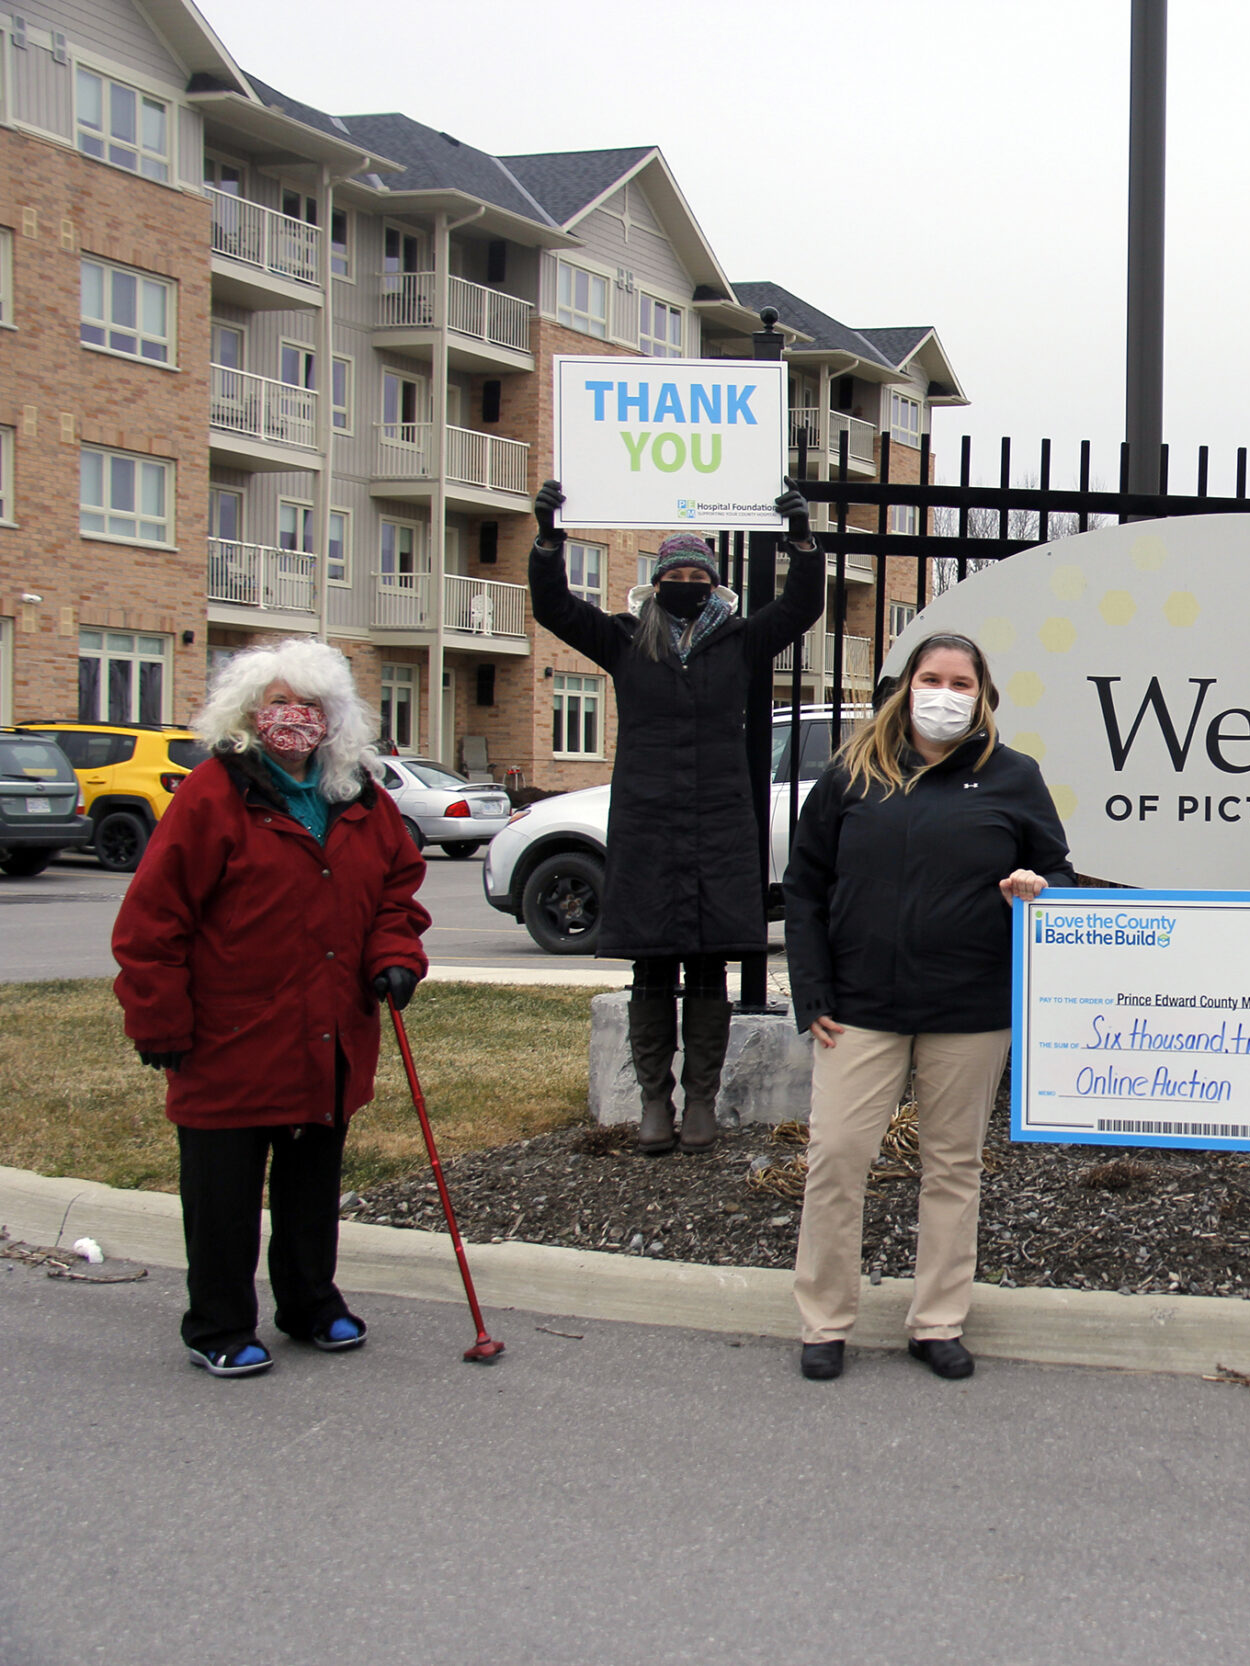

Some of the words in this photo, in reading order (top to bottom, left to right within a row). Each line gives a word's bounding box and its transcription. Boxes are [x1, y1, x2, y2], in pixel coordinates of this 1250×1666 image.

[585, 381, 758, 425] THANK
[620, 432, 722, 473] YOU
[697, 503, 730, 511] Hospital
[1105, 795, 1159, 821] OF
[1045, 912, 1084, 928] Love
[1086, 913, 1113, 929] the
[1115, 913, 1176, 935] County
[1045, 929, 1084, 944] Back
[1086, 930, 1113, 945] the
[1115, 930, 1156, 946] Build
[1117, 992, 1152, 1006] Prince
[1155, 994, 1196, 1008] Edward
[1200, 995, 1238, 1011] County
[1086, 1014, 1121, 1050] Six
[1076, 1065, 1149, 1096] Online
[1150, 1066, 1231, 1101] Auction
